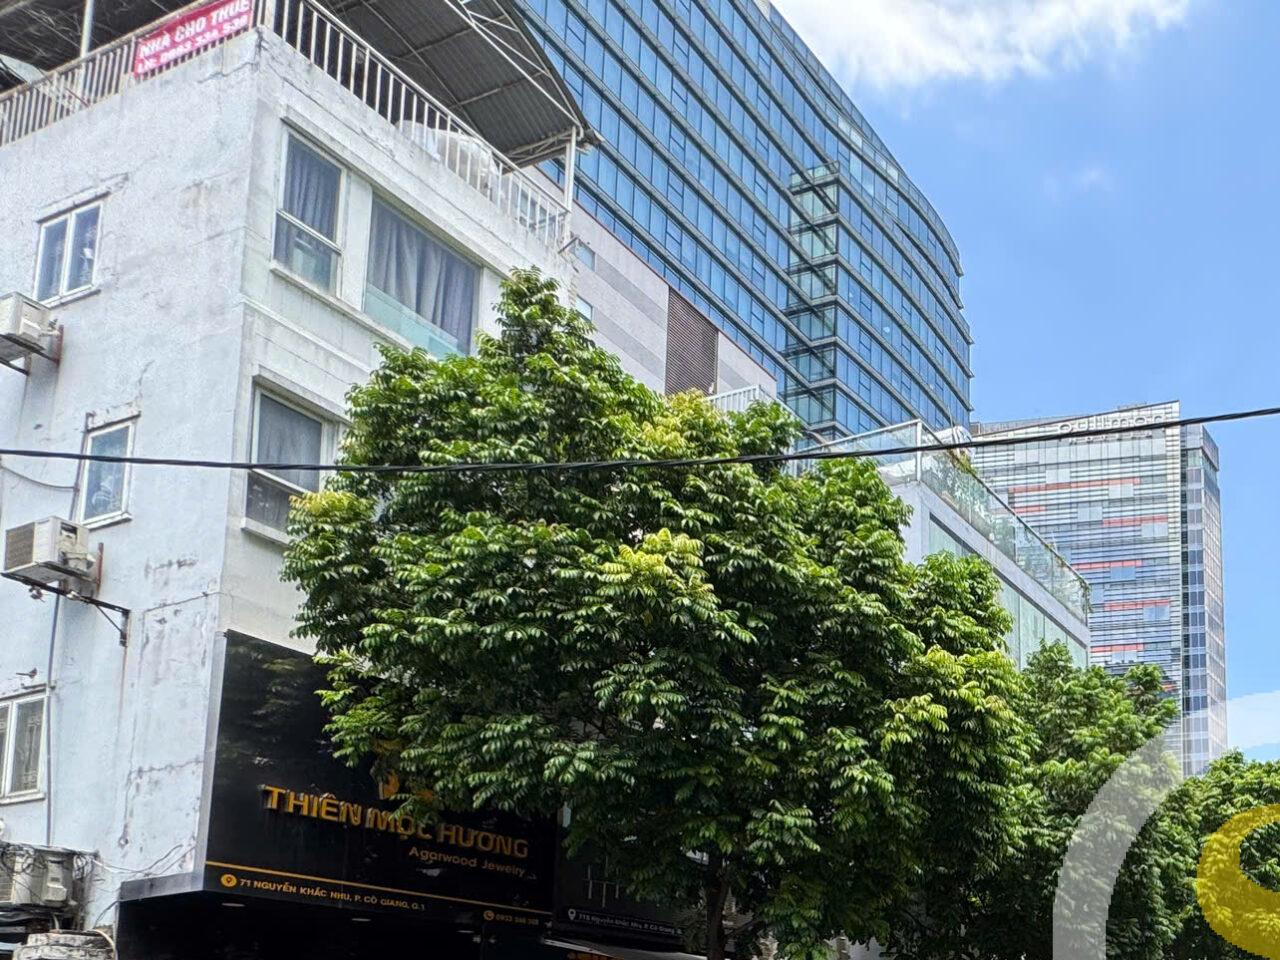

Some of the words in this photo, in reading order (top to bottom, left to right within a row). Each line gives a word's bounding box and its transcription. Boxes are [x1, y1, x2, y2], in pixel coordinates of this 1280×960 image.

[174, 16, 207, 43] CHO
[264, 784, 362, 827] THIÊN
[437, 822, 529, 859] HƯƠNG
[408, 846, 477, 869] Agarwood
[482, 859, 527, 879] Jewelry
[239, 878, 251, 888] 71
[253, 879, 297, 894] NGUYỄN
[299, 885, 327, 898] KHẮC
